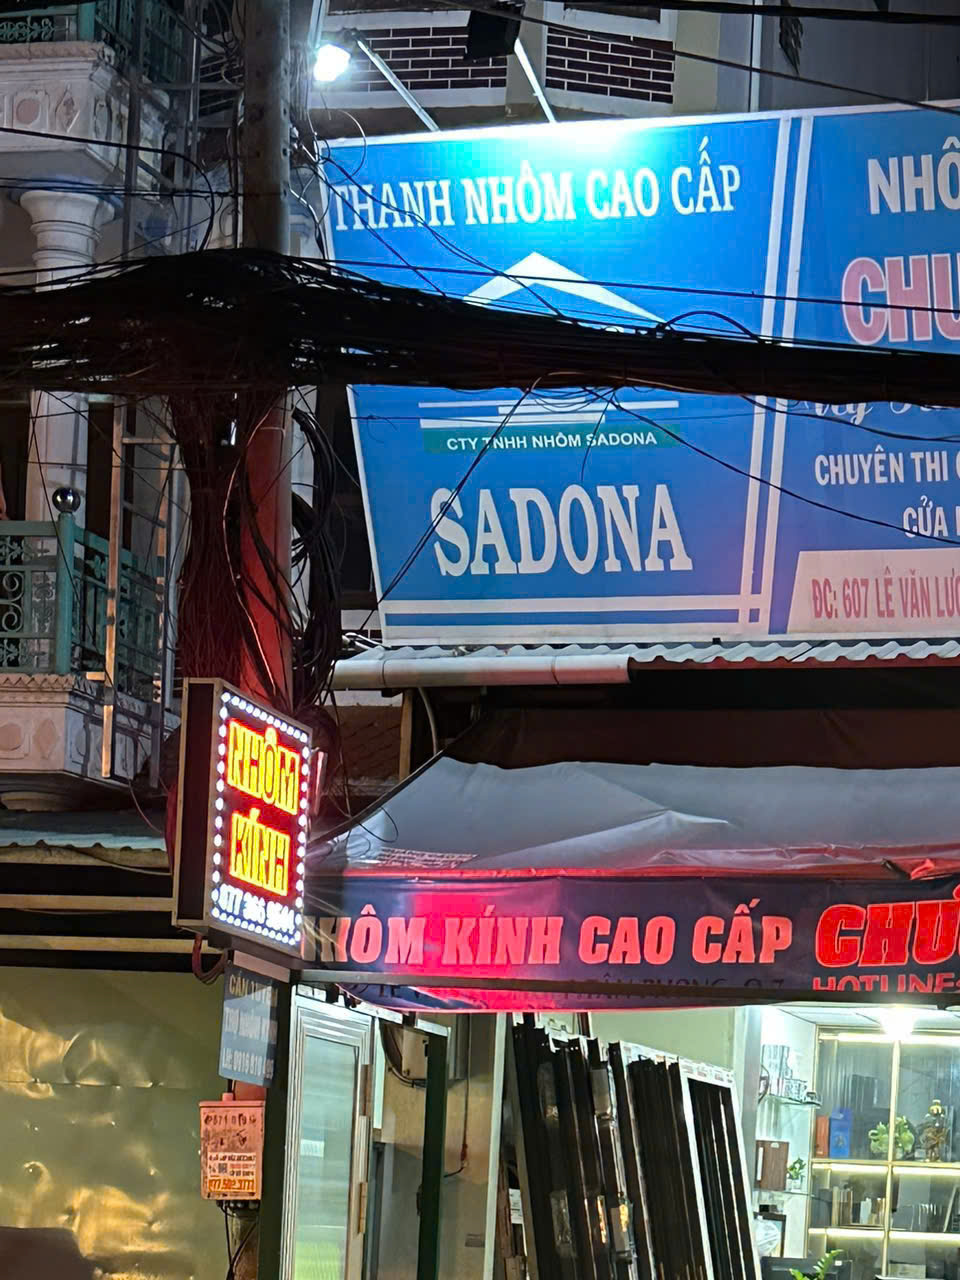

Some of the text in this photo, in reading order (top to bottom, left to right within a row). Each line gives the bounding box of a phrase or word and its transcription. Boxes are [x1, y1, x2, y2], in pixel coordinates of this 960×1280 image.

[335, 136, 741, 231] THANH NHÔM CAO CẤP
[447, 431, 658, 451] CTY TNHH NHÔM SADONA
[814, 444, 904, 487] CHUYÊN
[910, 450, 949, 483] THI
[431, 484, 693, 577] SADONA
[902, 495, 949, 538] CỬA
[811, 578, 839, 619] ĐC:
[842, 578, 870, 619] 607
[874, 565, 894, 618] LÊ
[899, 568, 932, 619] VĂN
[227, 725, 300, 816] NHÔM
[229, 807, 291, 897] KÍNH
[442, 904, 564, 965] KÍNH
[578, 917, 676, 966] CAO
[693, 898, 793, 966] CẤP
